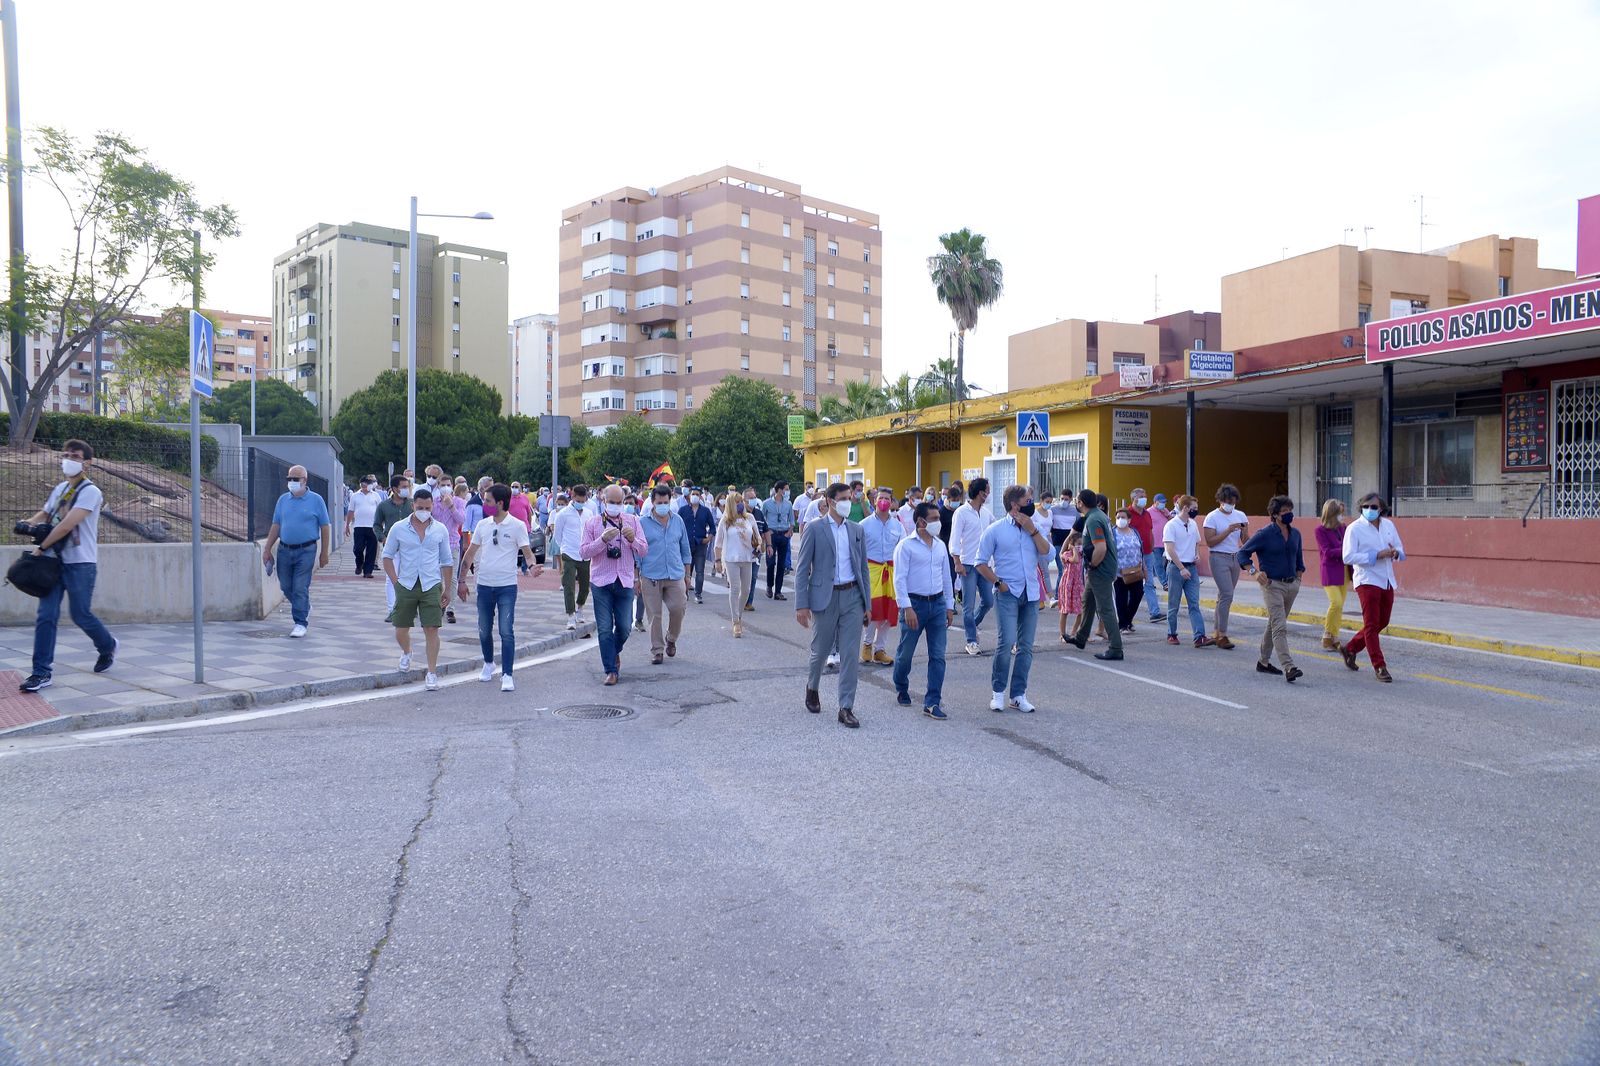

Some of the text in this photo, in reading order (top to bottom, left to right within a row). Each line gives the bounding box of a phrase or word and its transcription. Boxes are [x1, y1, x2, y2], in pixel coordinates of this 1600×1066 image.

[1379, 319, 1444, 351] POLLOS
[1449, 302, 1532, 341] ASADOS
[1191, 354, 1232, 363] Cristalería
[1192, 361, 1232, 370] Algecireña
